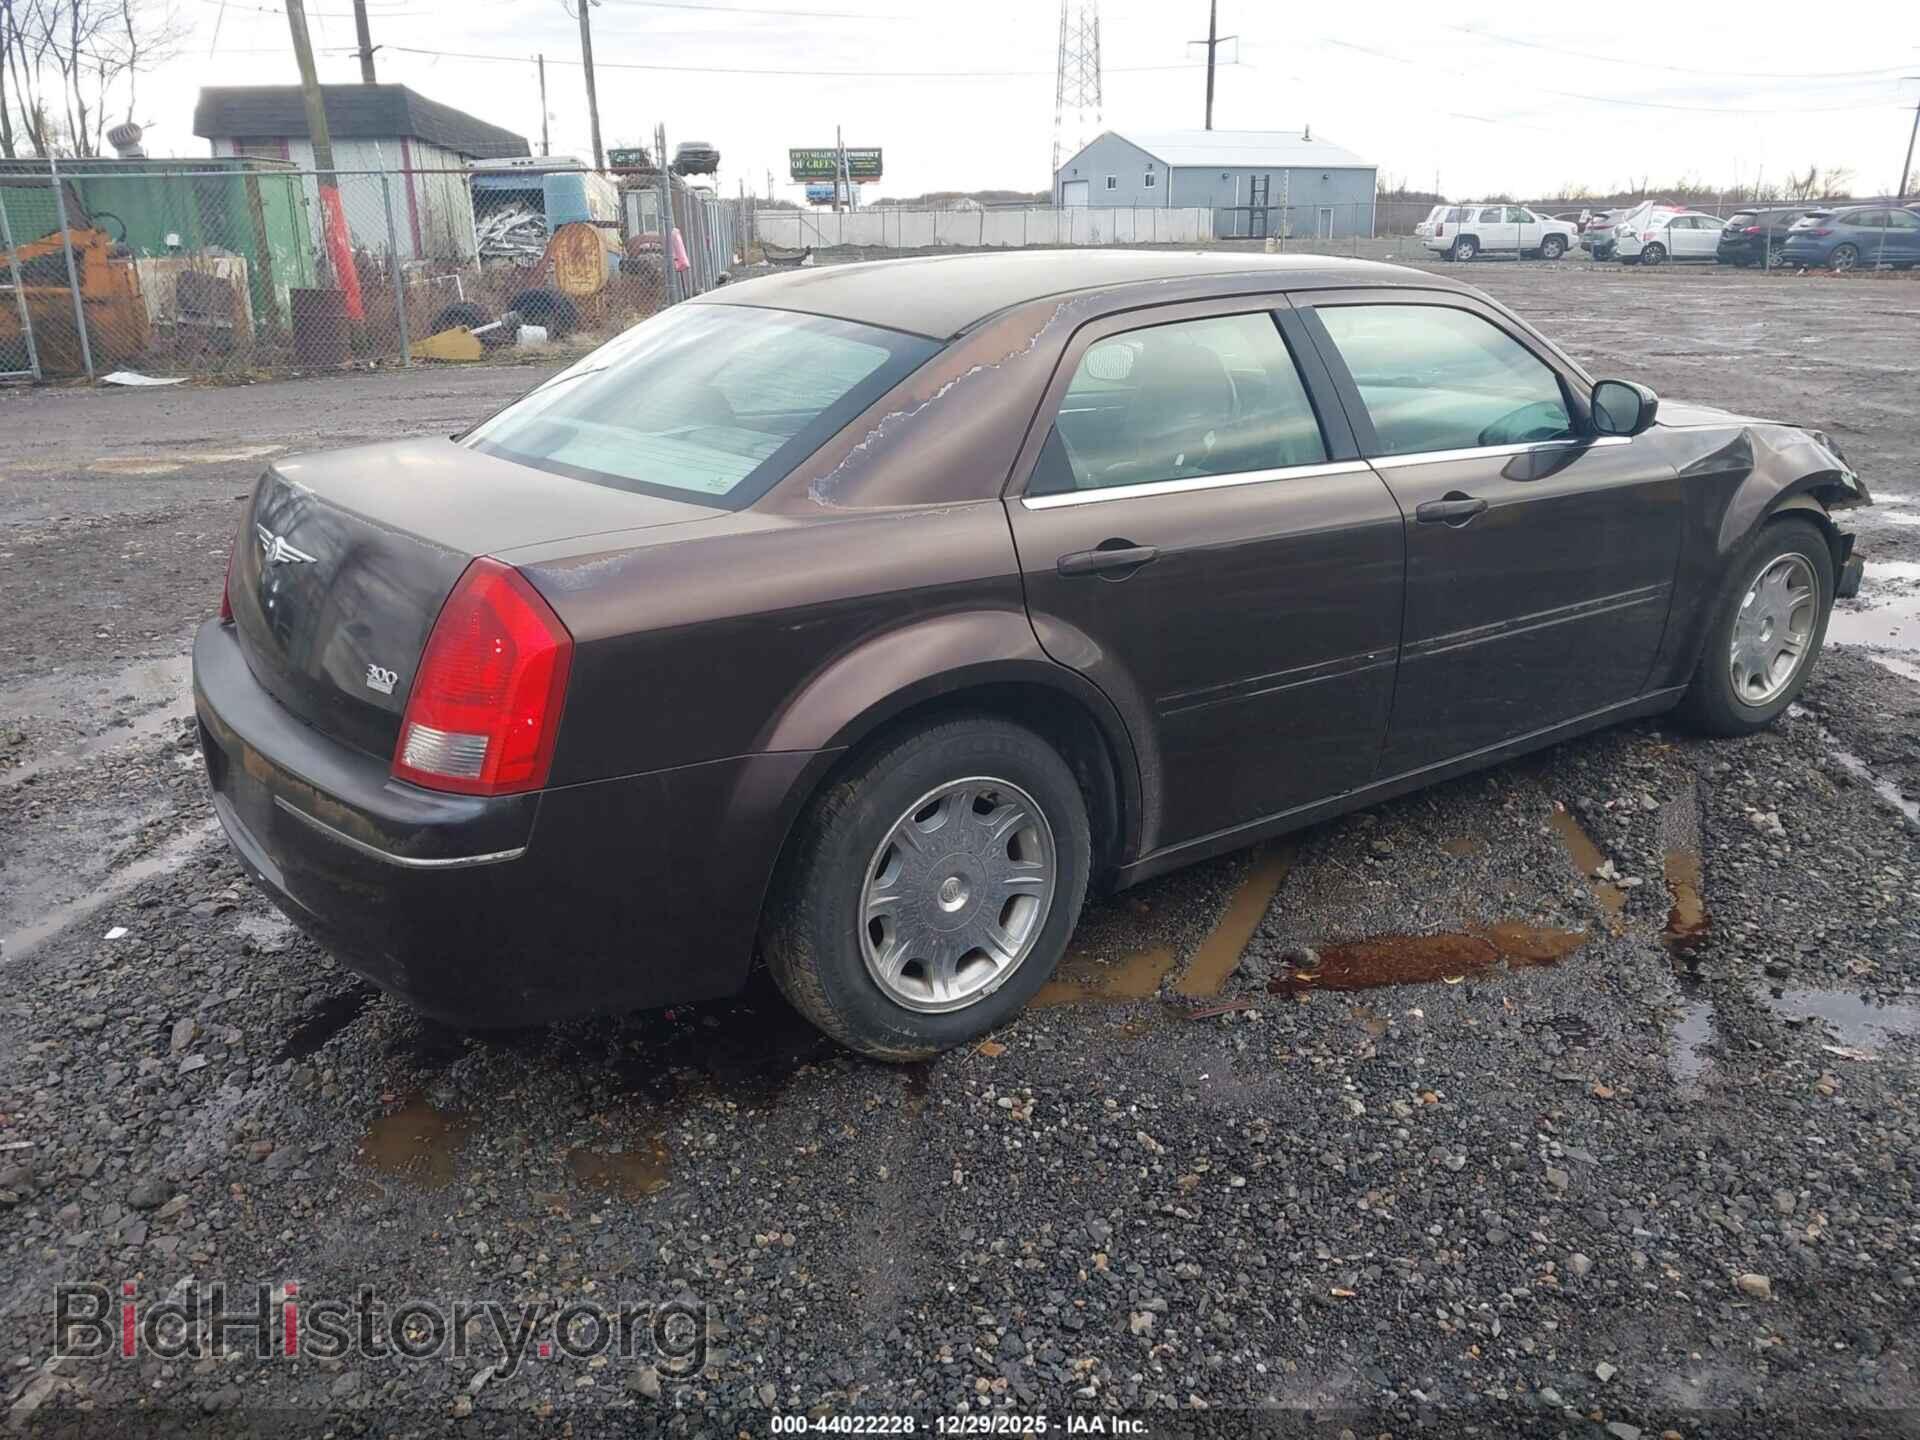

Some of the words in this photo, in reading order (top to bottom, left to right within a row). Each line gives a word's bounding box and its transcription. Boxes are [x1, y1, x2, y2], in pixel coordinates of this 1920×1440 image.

[792, 160, 805, 169] OF
[806, 160, 837, 169] GREEN
[366, 663, 398, 685] 300
